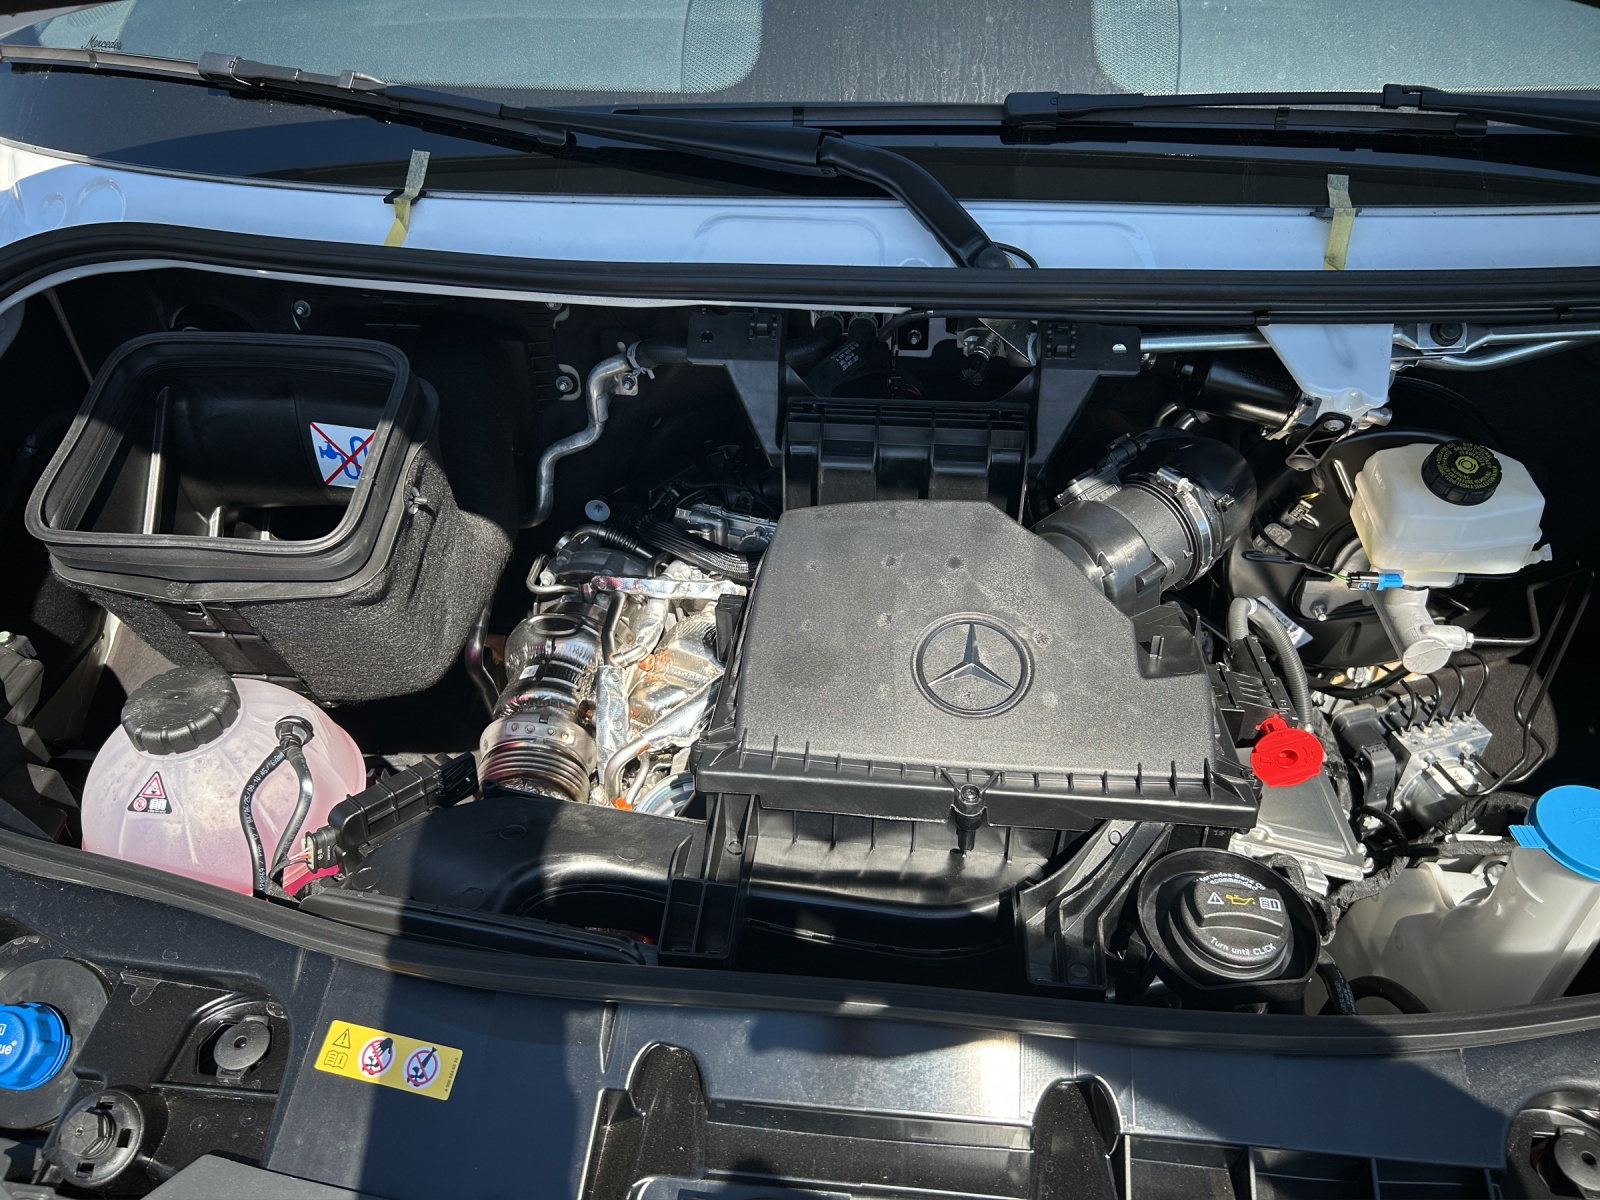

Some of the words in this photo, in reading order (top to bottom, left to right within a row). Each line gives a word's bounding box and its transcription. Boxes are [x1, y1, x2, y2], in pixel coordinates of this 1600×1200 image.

[1210, 936, 1229, 951] Turn
[1231, 947, 1250, 956] until
[1253, 943, 1276, 956] CLICK
